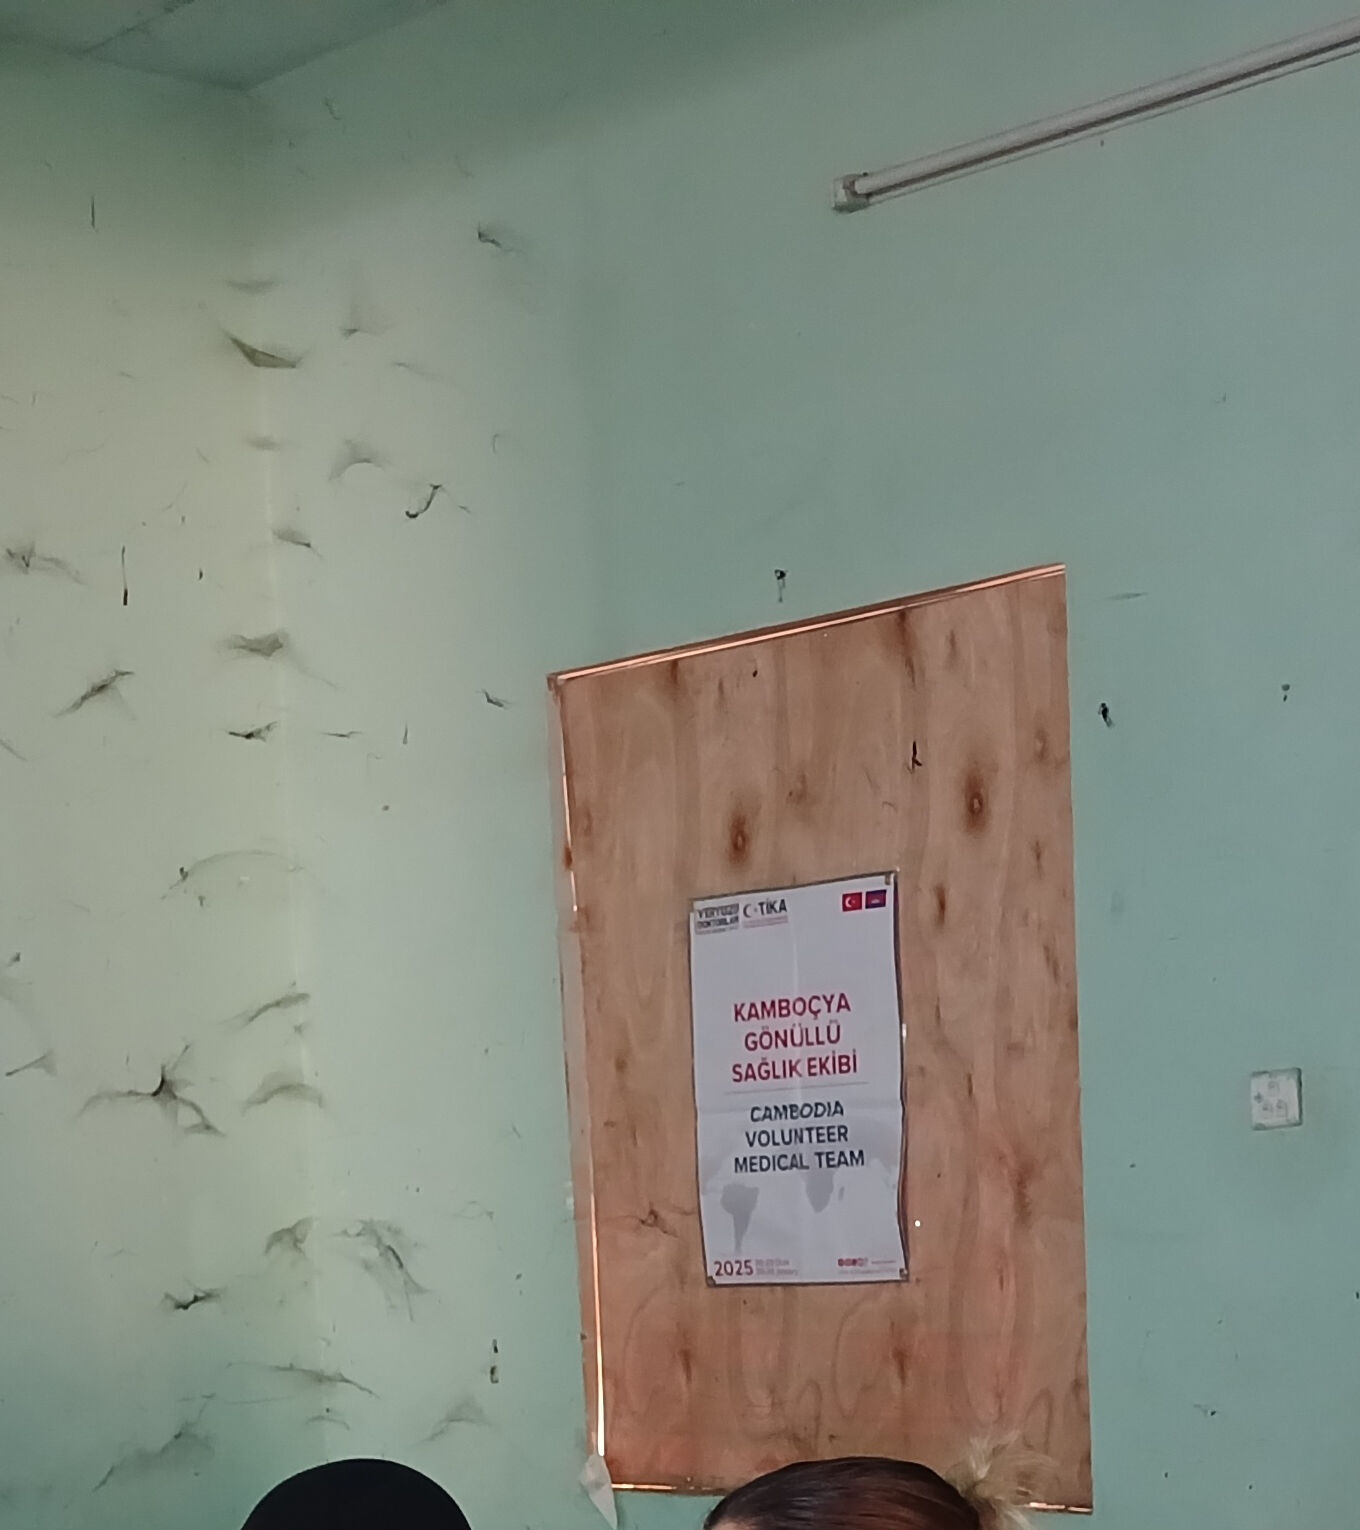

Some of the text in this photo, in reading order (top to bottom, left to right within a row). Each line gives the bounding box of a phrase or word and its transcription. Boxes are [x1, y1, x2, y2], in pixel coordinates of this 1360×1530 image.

[733, 992, 852, 1022] KAMBOÇYA
[744, 1019, 841, 1052] GÖNÜLLÜ
[731, 1048, 858, 1083] SAĞLIK EKİBİ
[750, 1100, 845, 1123] CAMBODIA
[745, 1124, 849, 1148] VOLUNTEER
[734, 1149, 866, 1174] MEDICAL TEAM
[714, 1260, 754, 1277] 2025
